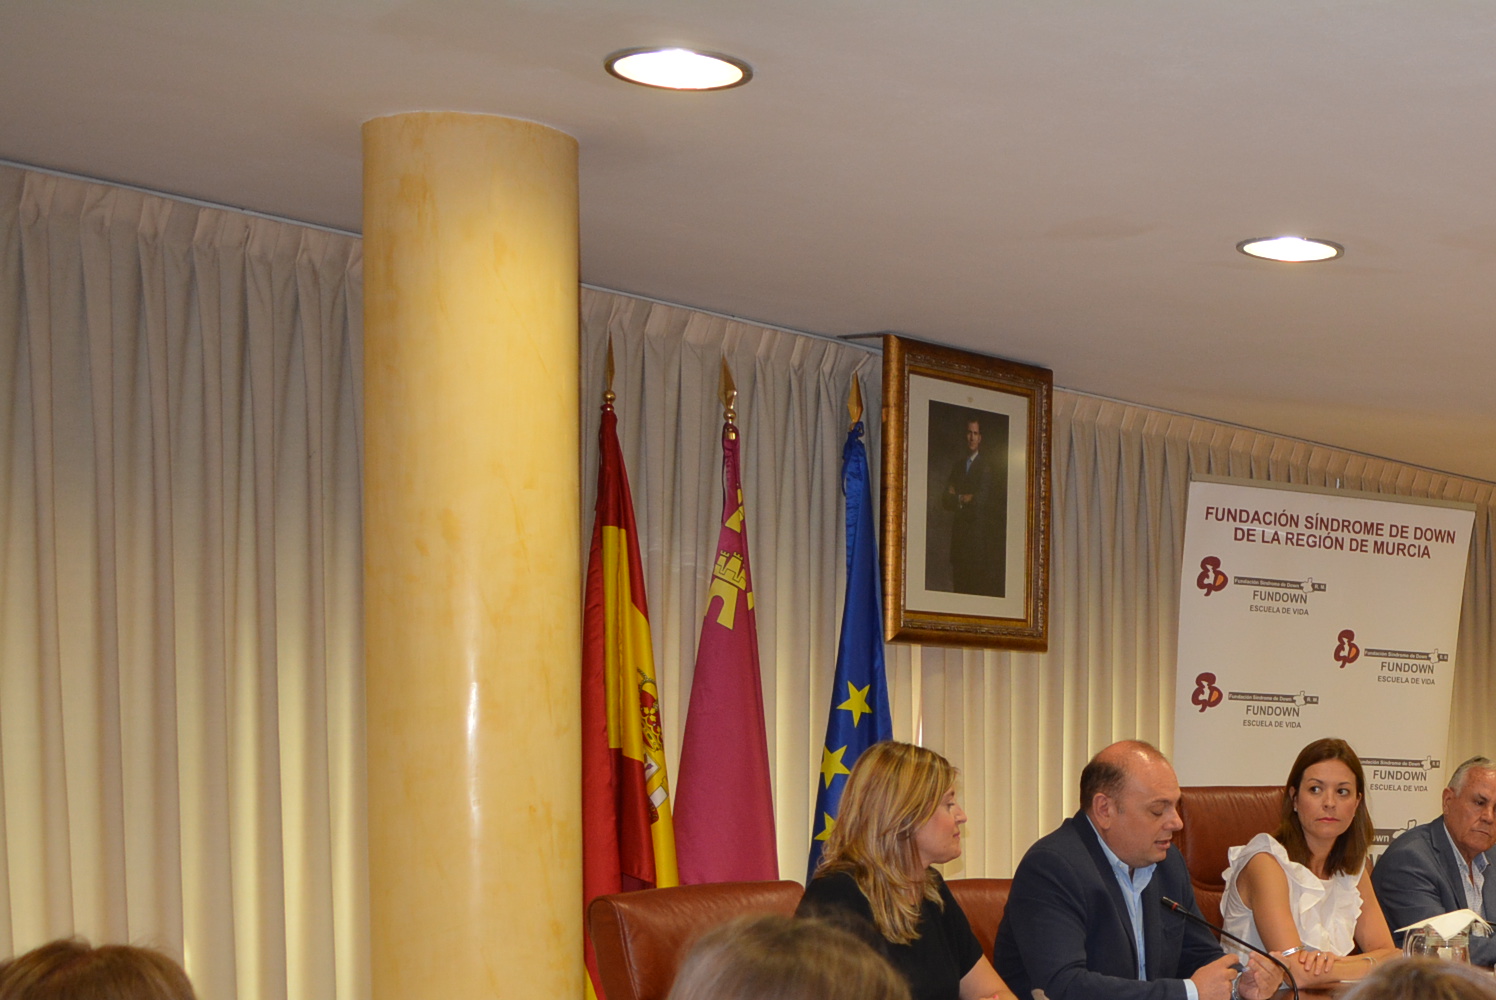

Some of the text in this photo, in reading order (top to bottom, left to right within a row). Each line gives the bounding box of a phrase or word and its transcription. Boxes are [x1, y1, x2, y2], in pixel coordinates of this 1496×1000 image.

[1204, 506, 1456, 545] FUNDACIÓN SÍNDROME DE DOWN
[1234, 527, 1431, 559] DE LA REGIÓN DE MURCIA
[1253, 590, 1308, 604] FUNDOWN
[1249, 605, 1280, 614] ESCUELA
[1292, 608, 1309, 616] VIDA
[1380, 661, 1434, 674] FUNDOWN
[1378, 675, 1409, 684] ESCUELA
[1246, 705, 1300, 717] FUNDOWN
[1243, 720, 1273, 728] ESCUELA
[1285, 721, 1301, 729] VIDA
[1373, 770, 1427, 781] FUNDOWN
